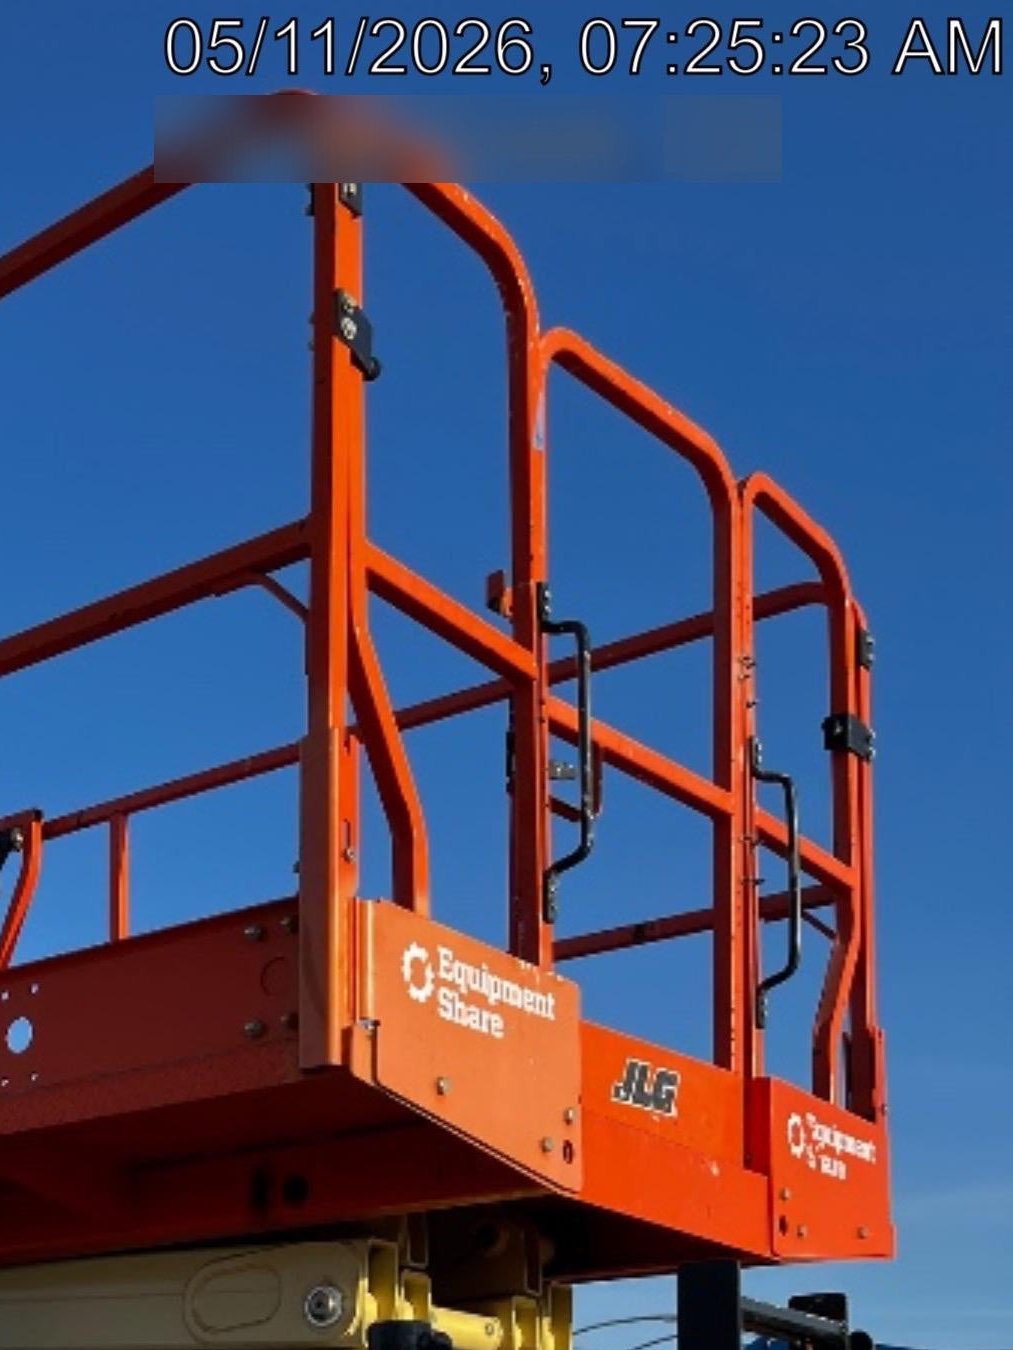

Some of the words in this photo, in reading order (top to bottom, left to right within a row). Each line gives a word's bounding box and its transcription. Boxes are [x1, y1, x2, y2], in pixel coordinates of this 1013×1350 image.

[438, 946, 555, 1020] Equipment
[438, 987, 504, 1038] Share
[610, 1057, 680, 1117] JLG
